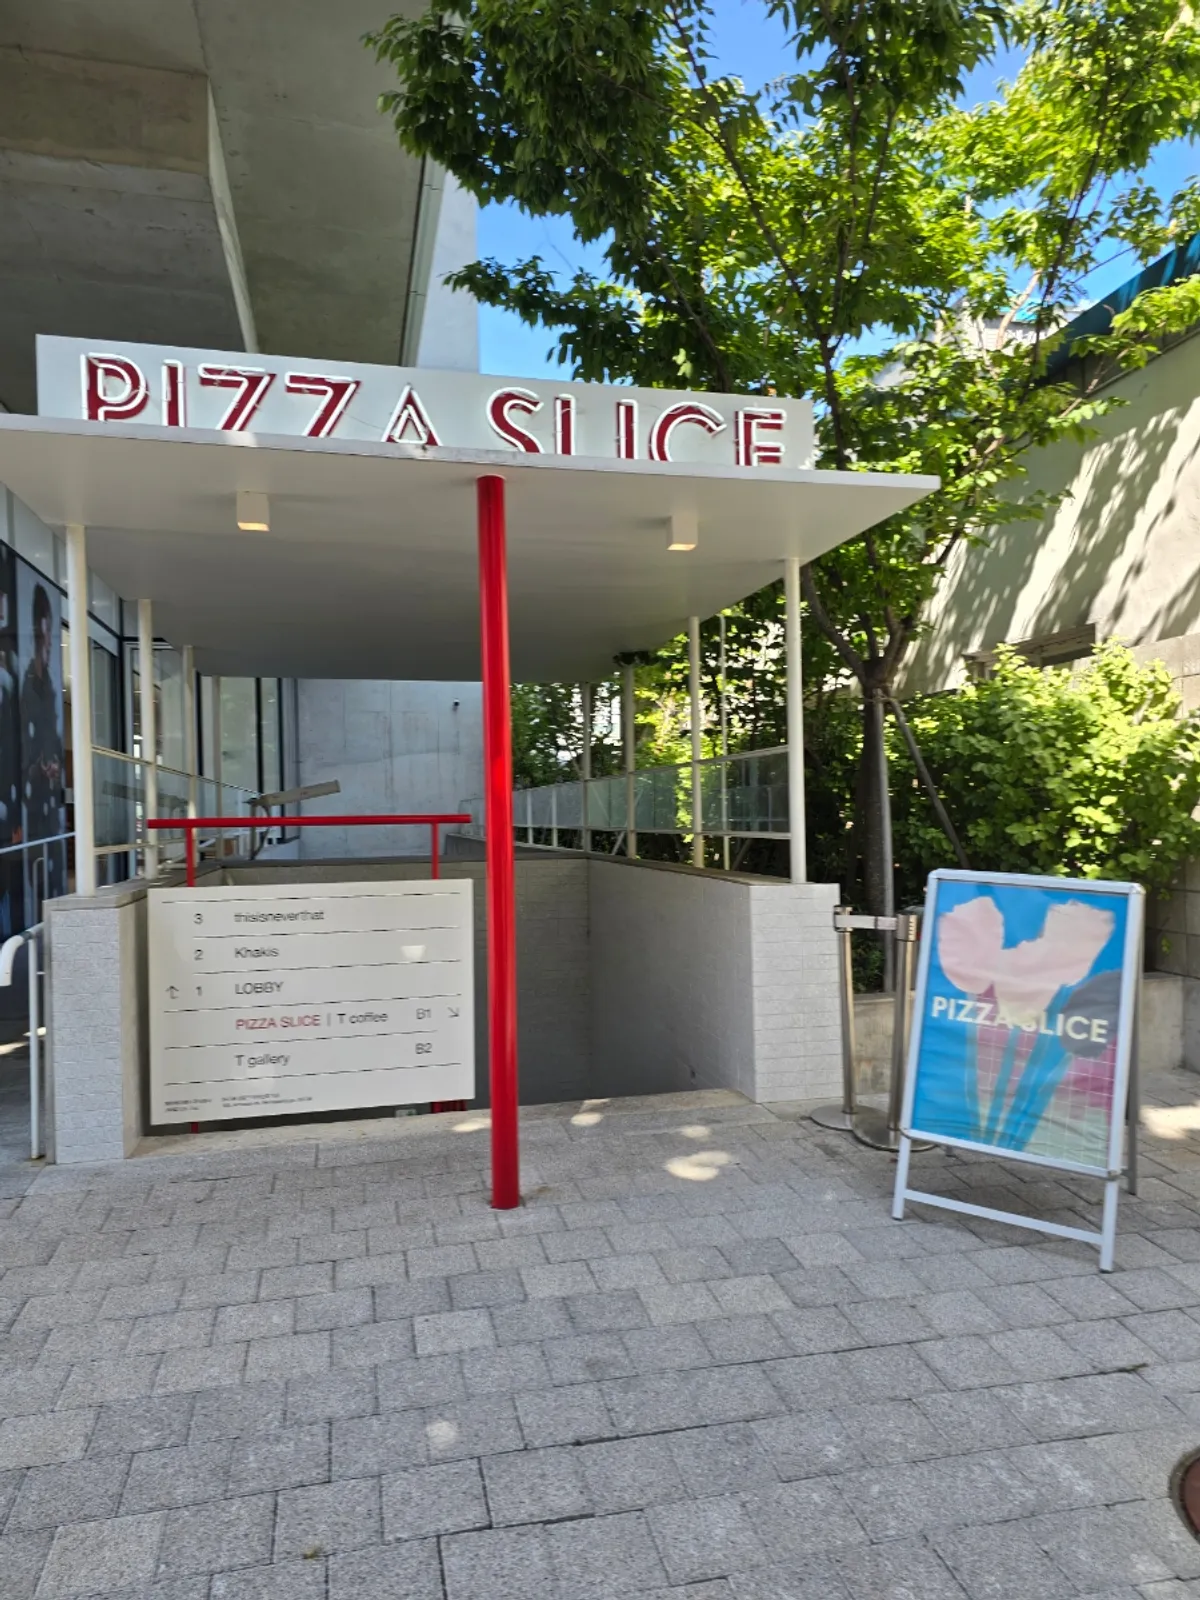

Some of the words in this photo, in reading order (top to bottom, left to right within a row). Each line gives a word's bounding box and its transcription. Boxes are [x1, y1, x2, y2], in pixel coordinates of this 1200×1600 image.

[193, 912, 204, 925] 3
[193, 948, 204, 961] 2
[234, 946, 280, 959] Khakis
[195, 985, 203, 997] 1
[234, 981, 284, 995] LOBBY
[235, 1017, 278, 1030] PIZZA
[280, 1014, 320, 1028] SLICE
[336, 1012, 346, 1024] T
[348, 1010, 388, 1024] coffee
[415, 1007, 432, 1020] B1
[931, 995, 1015, 1030] PIZZA
[1018, 1010, 1109, 1044] SLICE
[234, 1054, 245, 1066] T
[247, 1053, 290, 1068] gallery
[415, 1042, 433, 1055] B2
